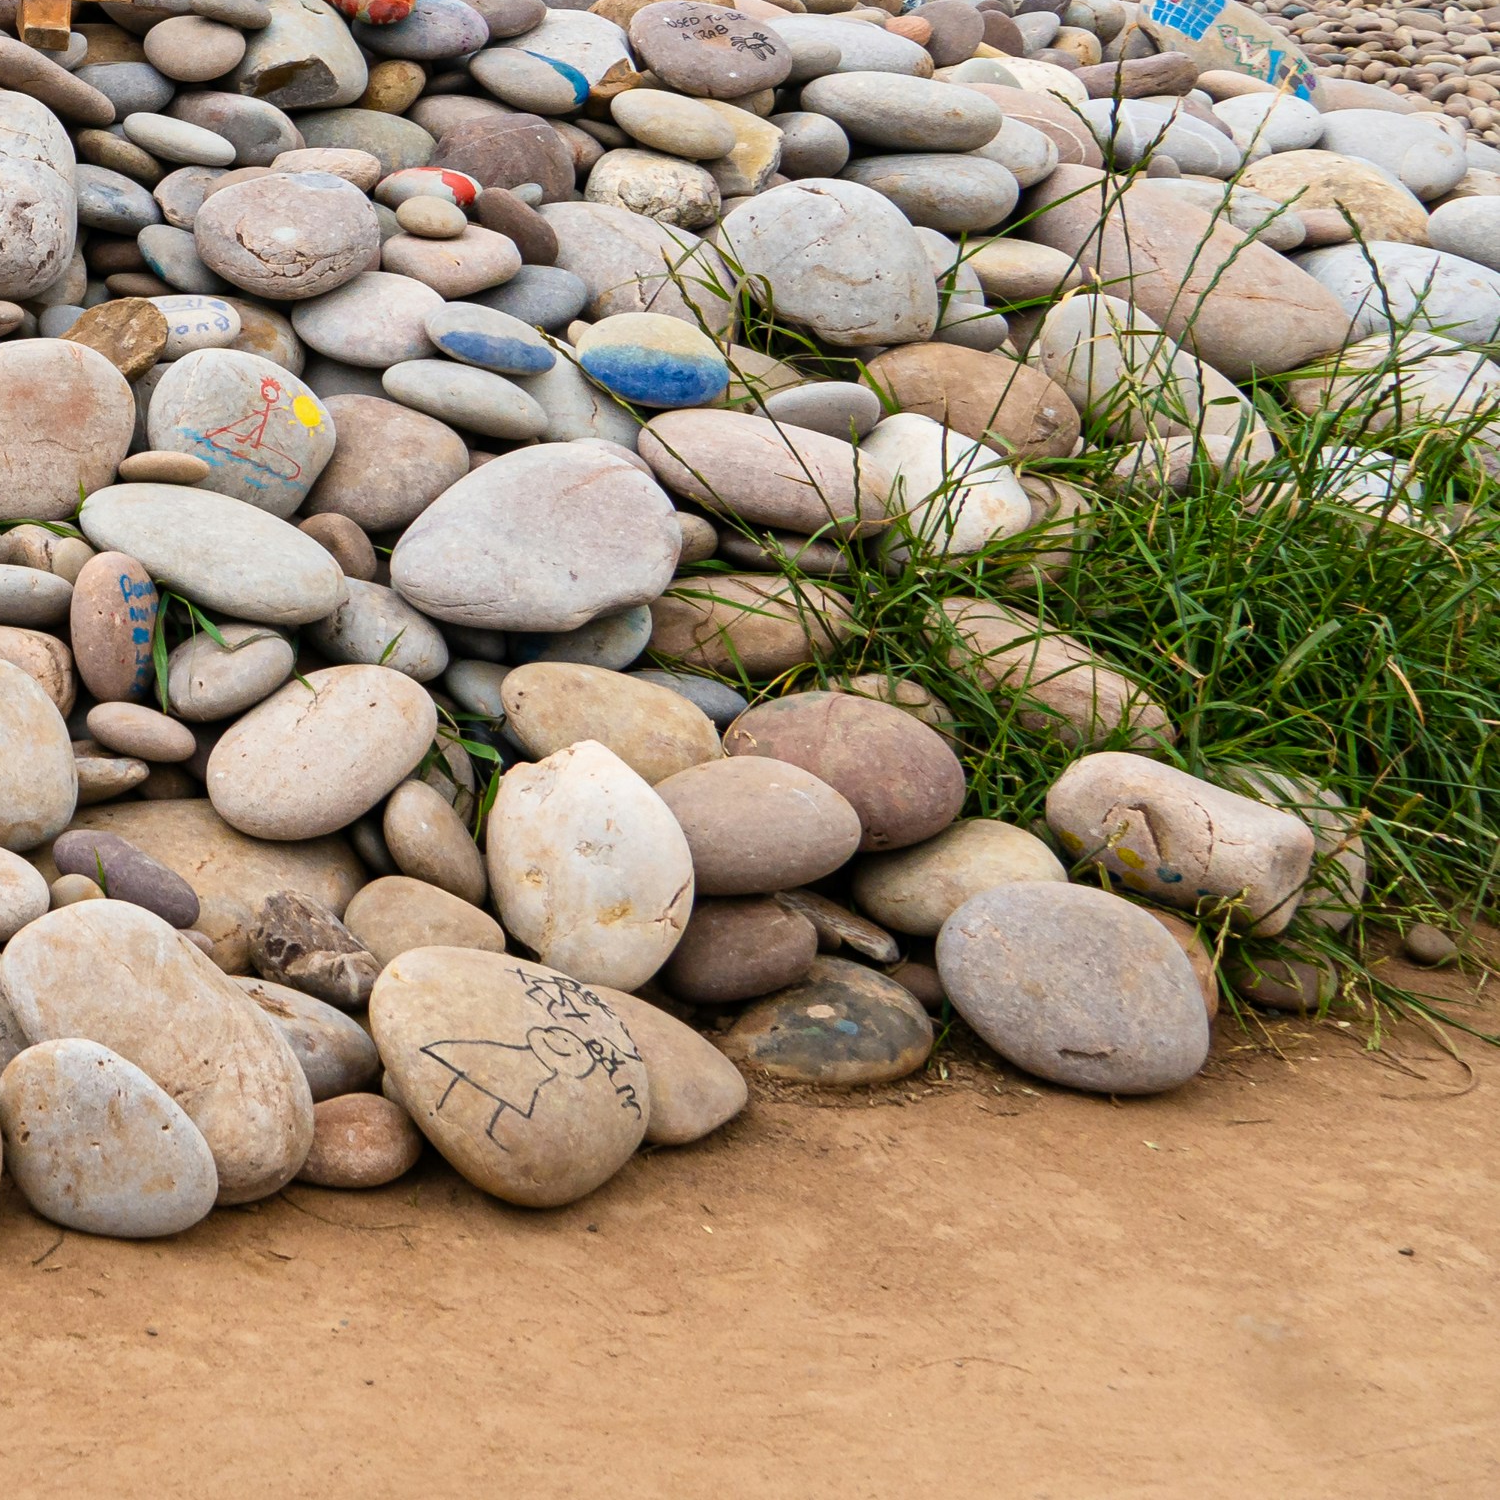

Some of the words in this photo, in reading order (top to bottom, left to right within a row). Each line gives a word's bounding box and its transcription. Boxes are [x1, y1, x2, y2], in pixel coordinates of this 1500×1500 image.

[666, 16, 700, 28] USED
[704, 14, 722, 24] TO
[724, 12, 748, 21] BE
[681, 32, 692, 41] A
[692, 24, 729, 40] CRAB
